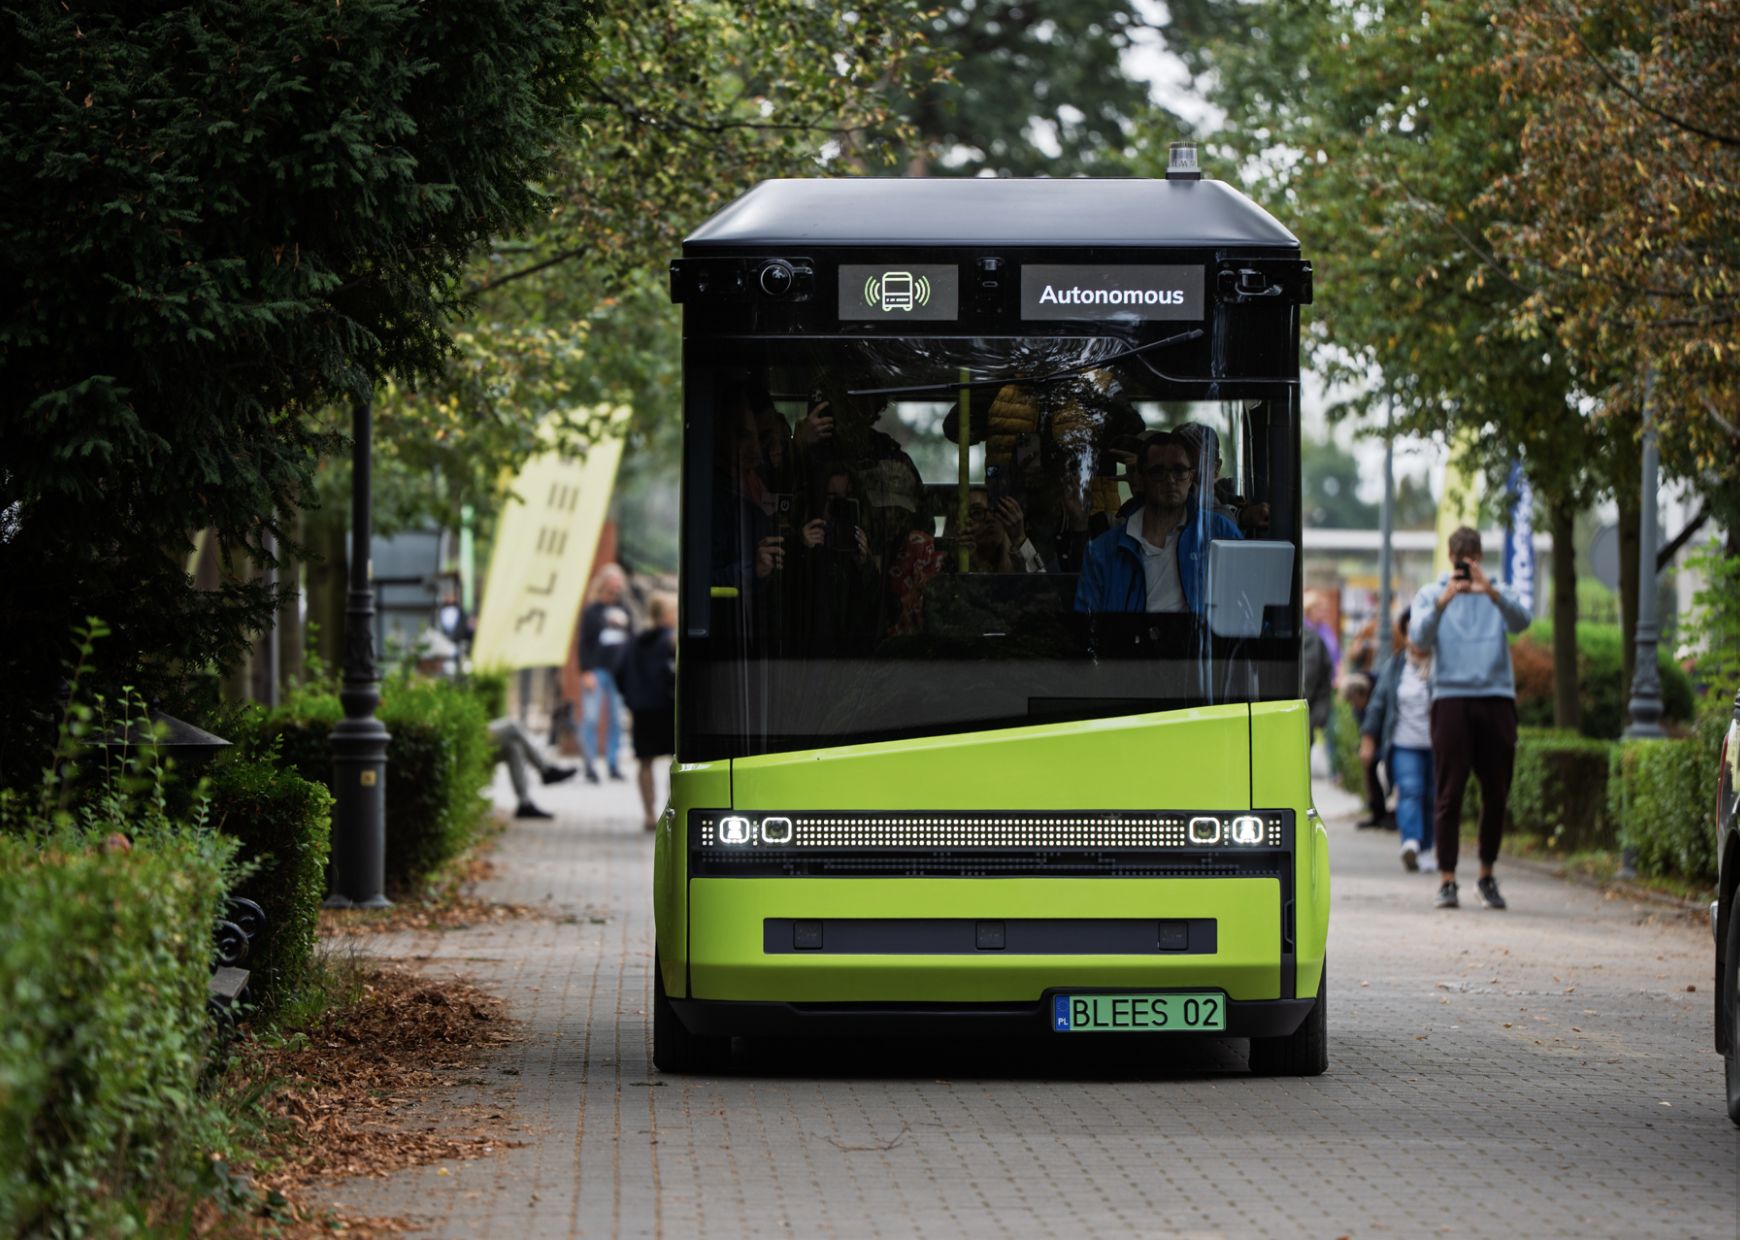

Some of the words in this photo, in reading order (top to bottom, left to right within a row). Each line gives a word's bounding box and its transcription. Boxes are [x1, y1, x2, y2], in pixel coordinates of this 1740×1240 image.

[1038, 285, 1185, 305] Autonomous
[1057, 1017, 1069, 1026] PL
[1072, 998, 1169, 1027] BLEES
[1183, 998, 1219, 1027] 02
